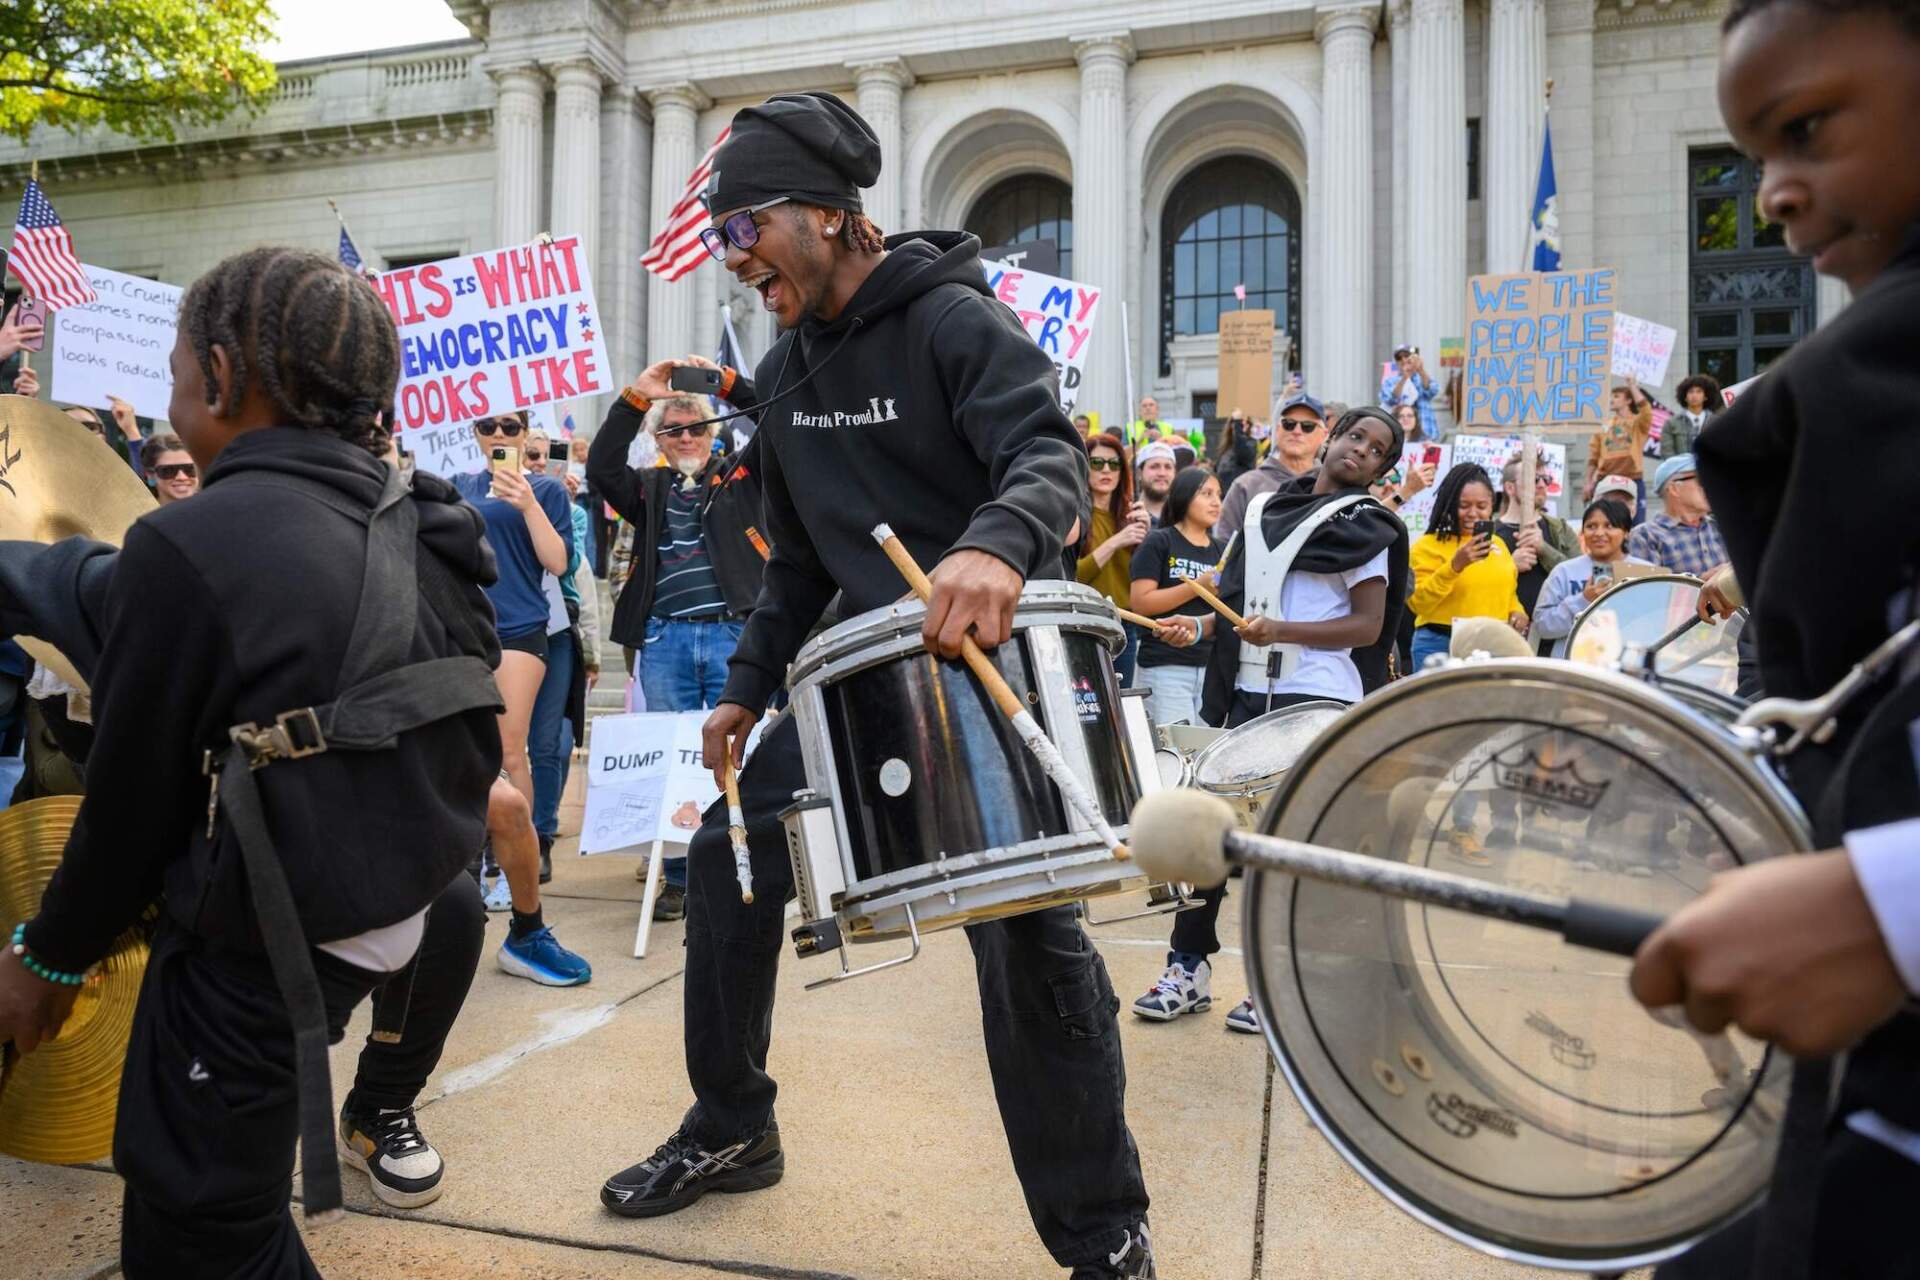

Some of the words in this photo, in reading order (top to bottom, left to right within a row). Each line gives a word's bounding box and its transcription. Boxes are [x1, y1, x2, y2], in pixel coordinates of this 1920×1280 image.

[370, 265, 453, 326] HIS
[453, 276, 476, 296] IS
[473, 237, 582, 309] WHAT
[1472, 278, 1532, 314] WE
[1543, 269, 1615, 308] THE
[1040, 286, 1099, 323] MY
[60, 318, 161, 350] Compassion
[402, 304, 569, 378] EMOCRACY
[1017, 310, 1090, 360] TRY
[1470, 310, 1615, 357] PEOPLE
[508, 349, 600, 408] LIKE
[1466, 351, 1537, 386] HAVE
[1538, 347, 1608, 384] THE
[1466, 381, 1603, 425] POWER
[602, 749, 664, 772] DUMP
